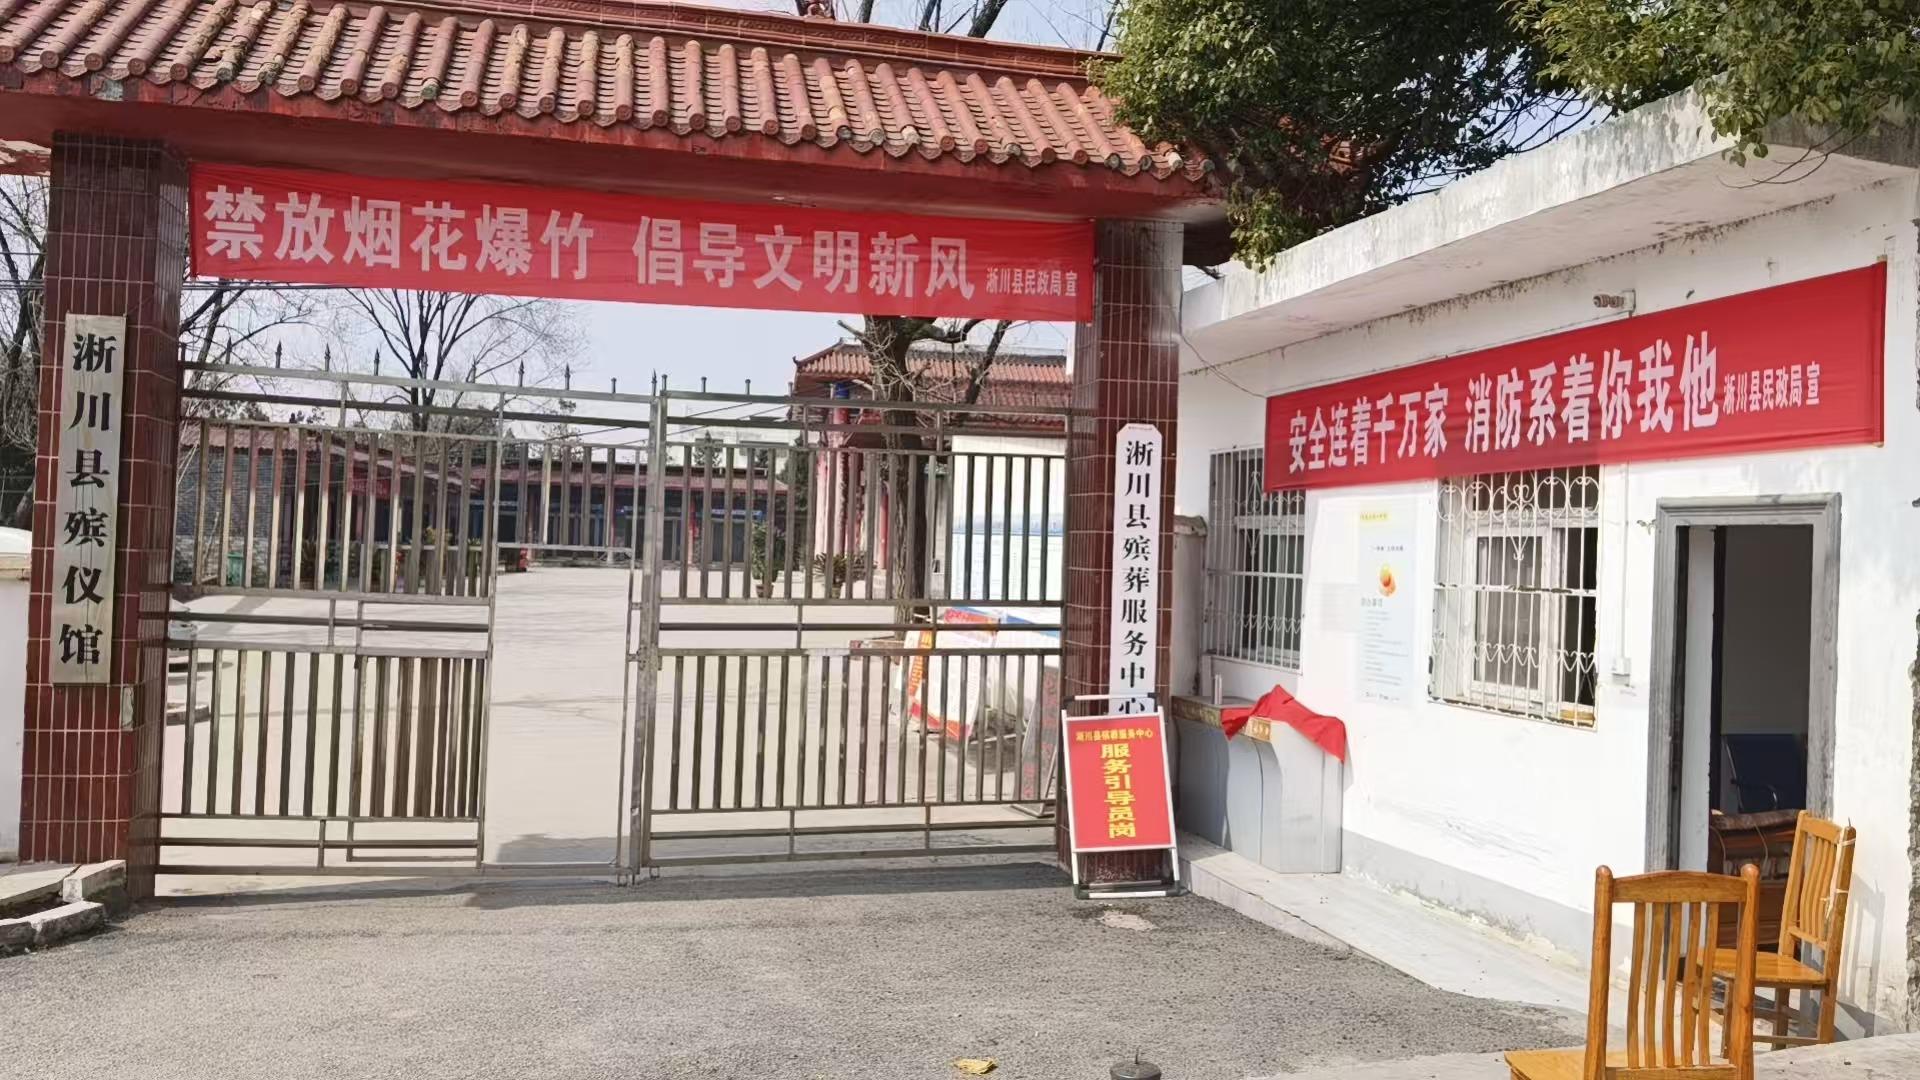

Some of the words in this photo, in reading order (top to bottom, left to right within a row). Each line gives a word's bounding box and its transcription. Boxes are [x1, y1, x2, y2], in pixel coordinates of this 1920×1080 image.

[203, 184, 594, 280] 禁放烟花爆竹
[632, 215, 975, 300] 倡导文明新风
[1288, 382, 1449, 474] 安全连着千万家
[1464, 330, 1719, 454] 消防系着你我他
[58, 333, 117, 666] 淅川县殡仪馆
[1100, 742, 1137, 839] 服务引导员岗
